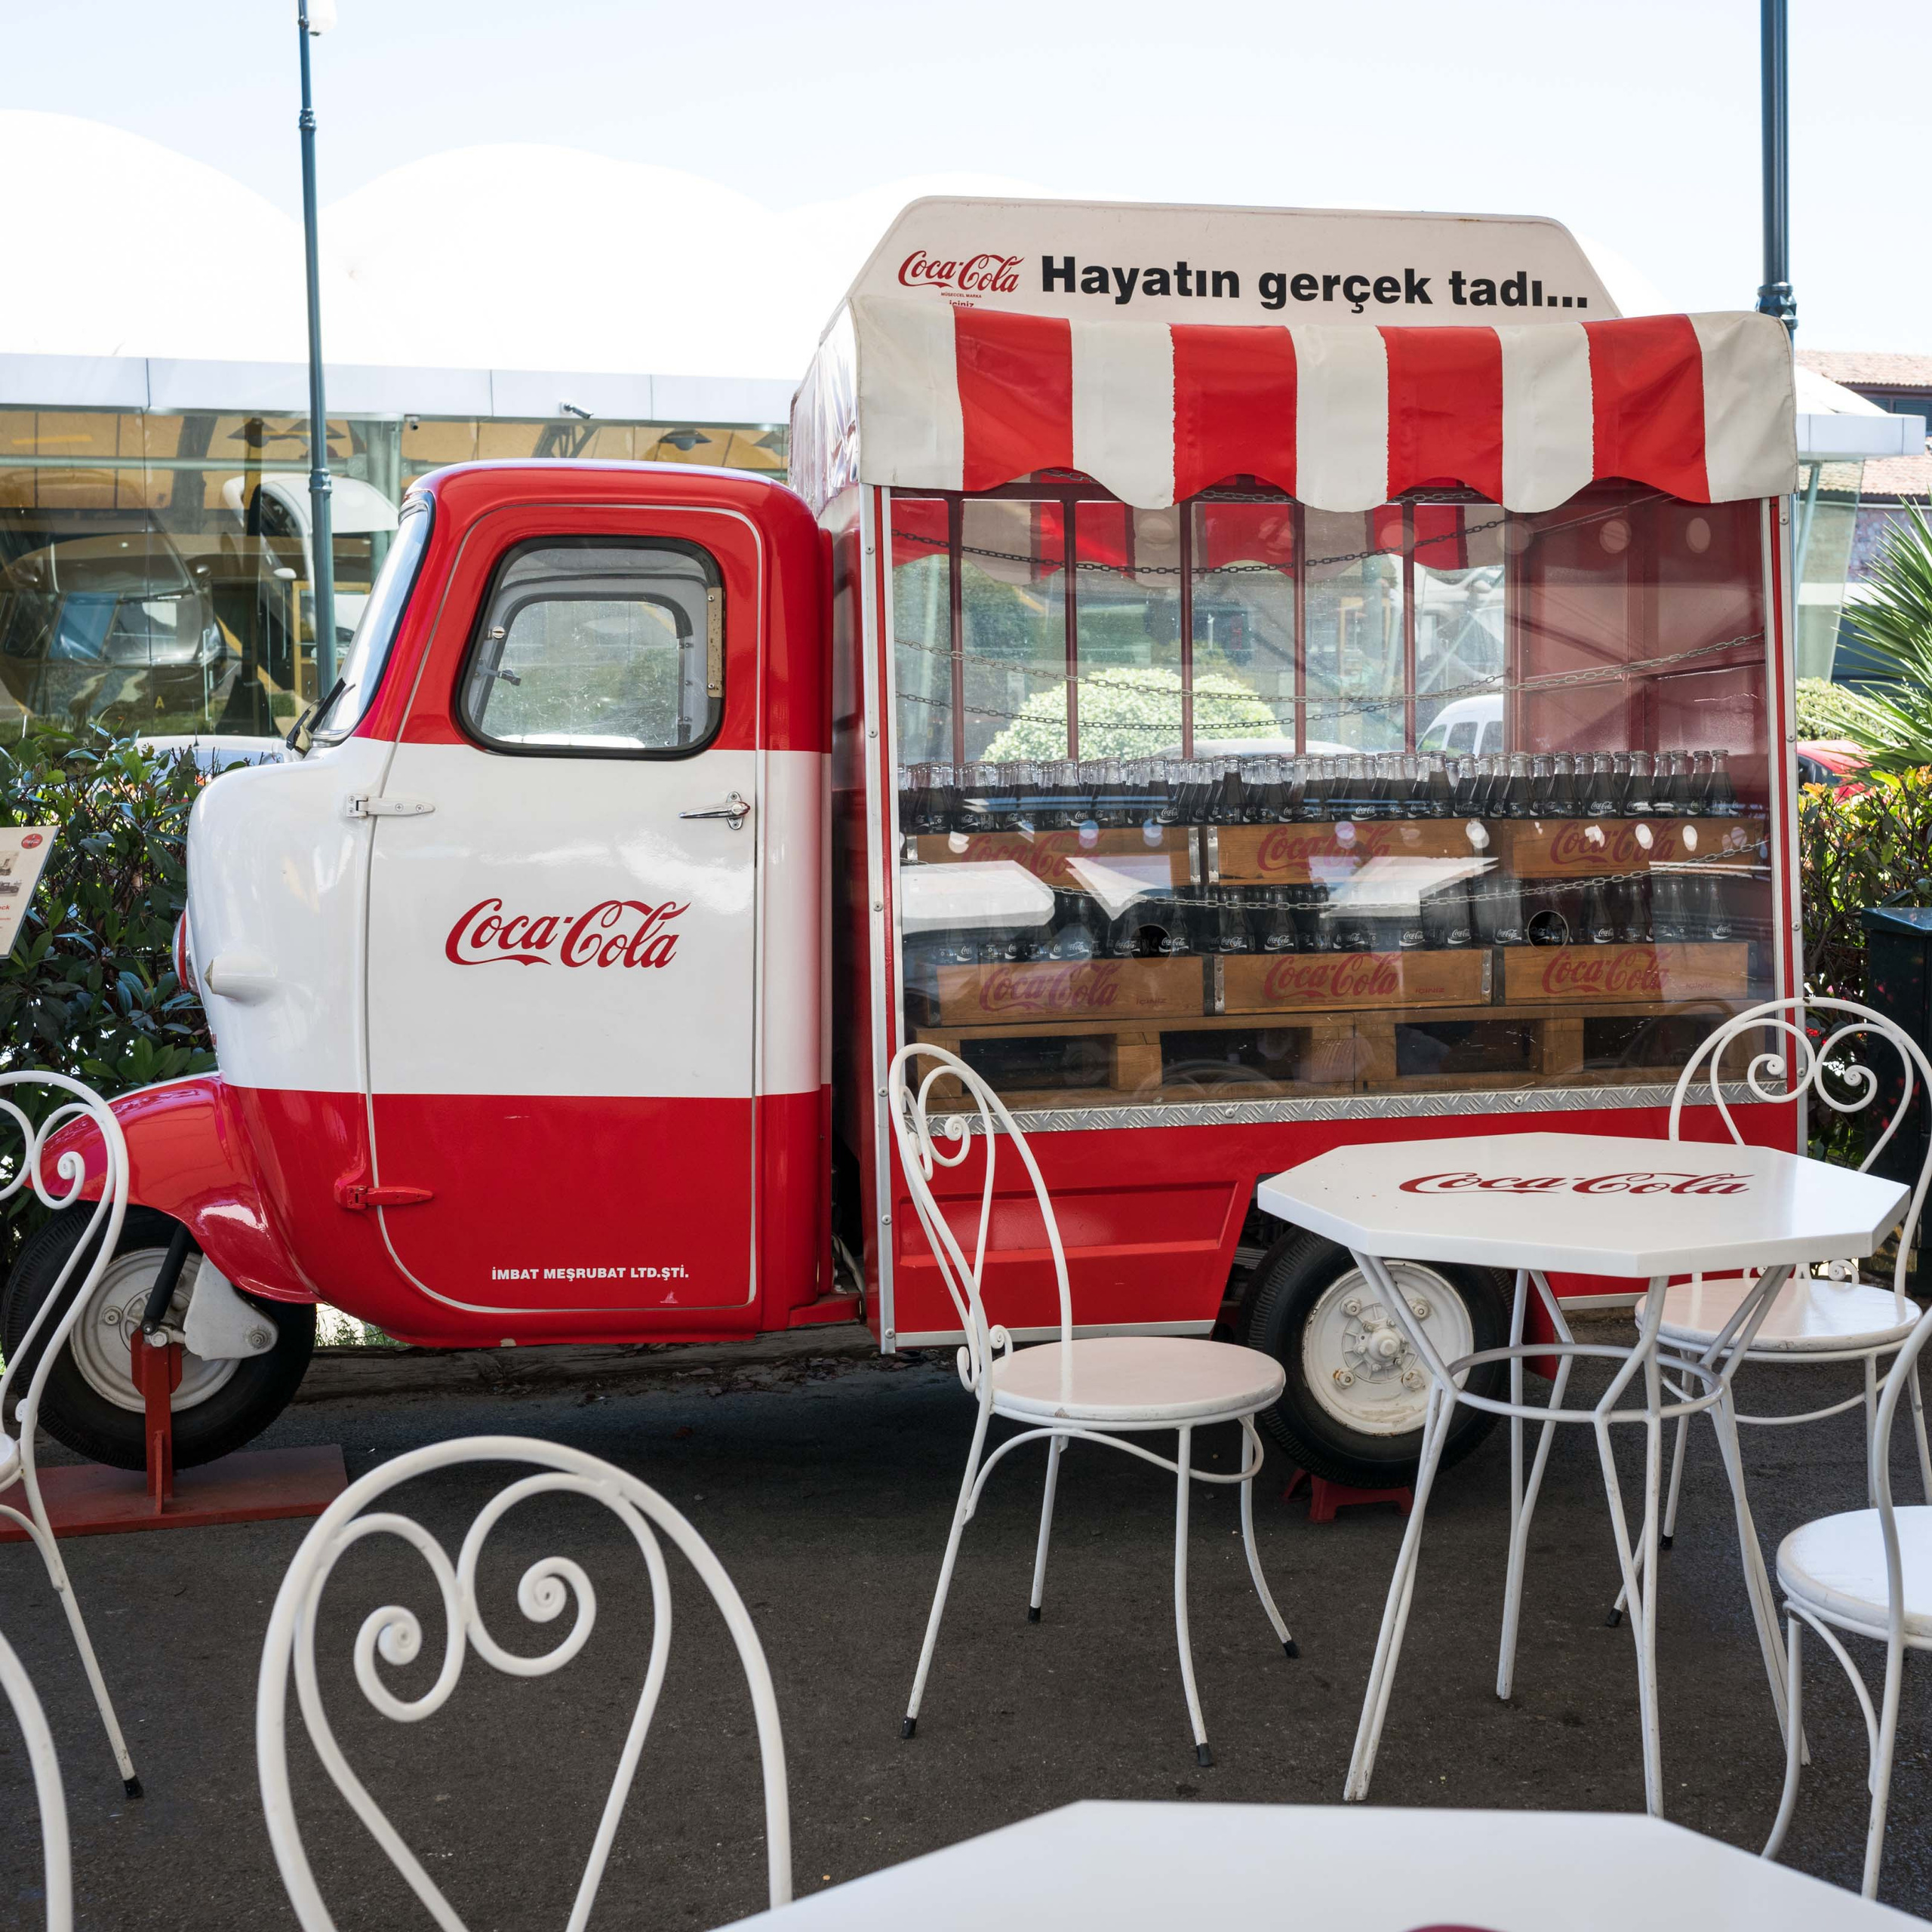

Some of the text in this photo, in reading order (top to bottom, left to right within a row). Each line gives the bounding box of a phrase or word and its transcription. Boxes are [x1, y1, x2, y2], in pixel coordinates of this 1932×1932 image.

[898, 251, 1025, 293] Coca-Cola
[1042, 255, 1588, 313] Hayatın gerçek tadı...
[445, 898, 692, 968] Coca-Cola
[980, 961, 1123, 1012] Coca-Cola
[1263, 952, 1402, 1001] Coca-Cola
[1542, 948, 1674, 995] Coca-Cola
[1398, 1172, 1755, 1195] Coca-Cola
[492, 1264, 689, 1281] İMBAT MEŞRUBAT LTD.ŞTİ.
